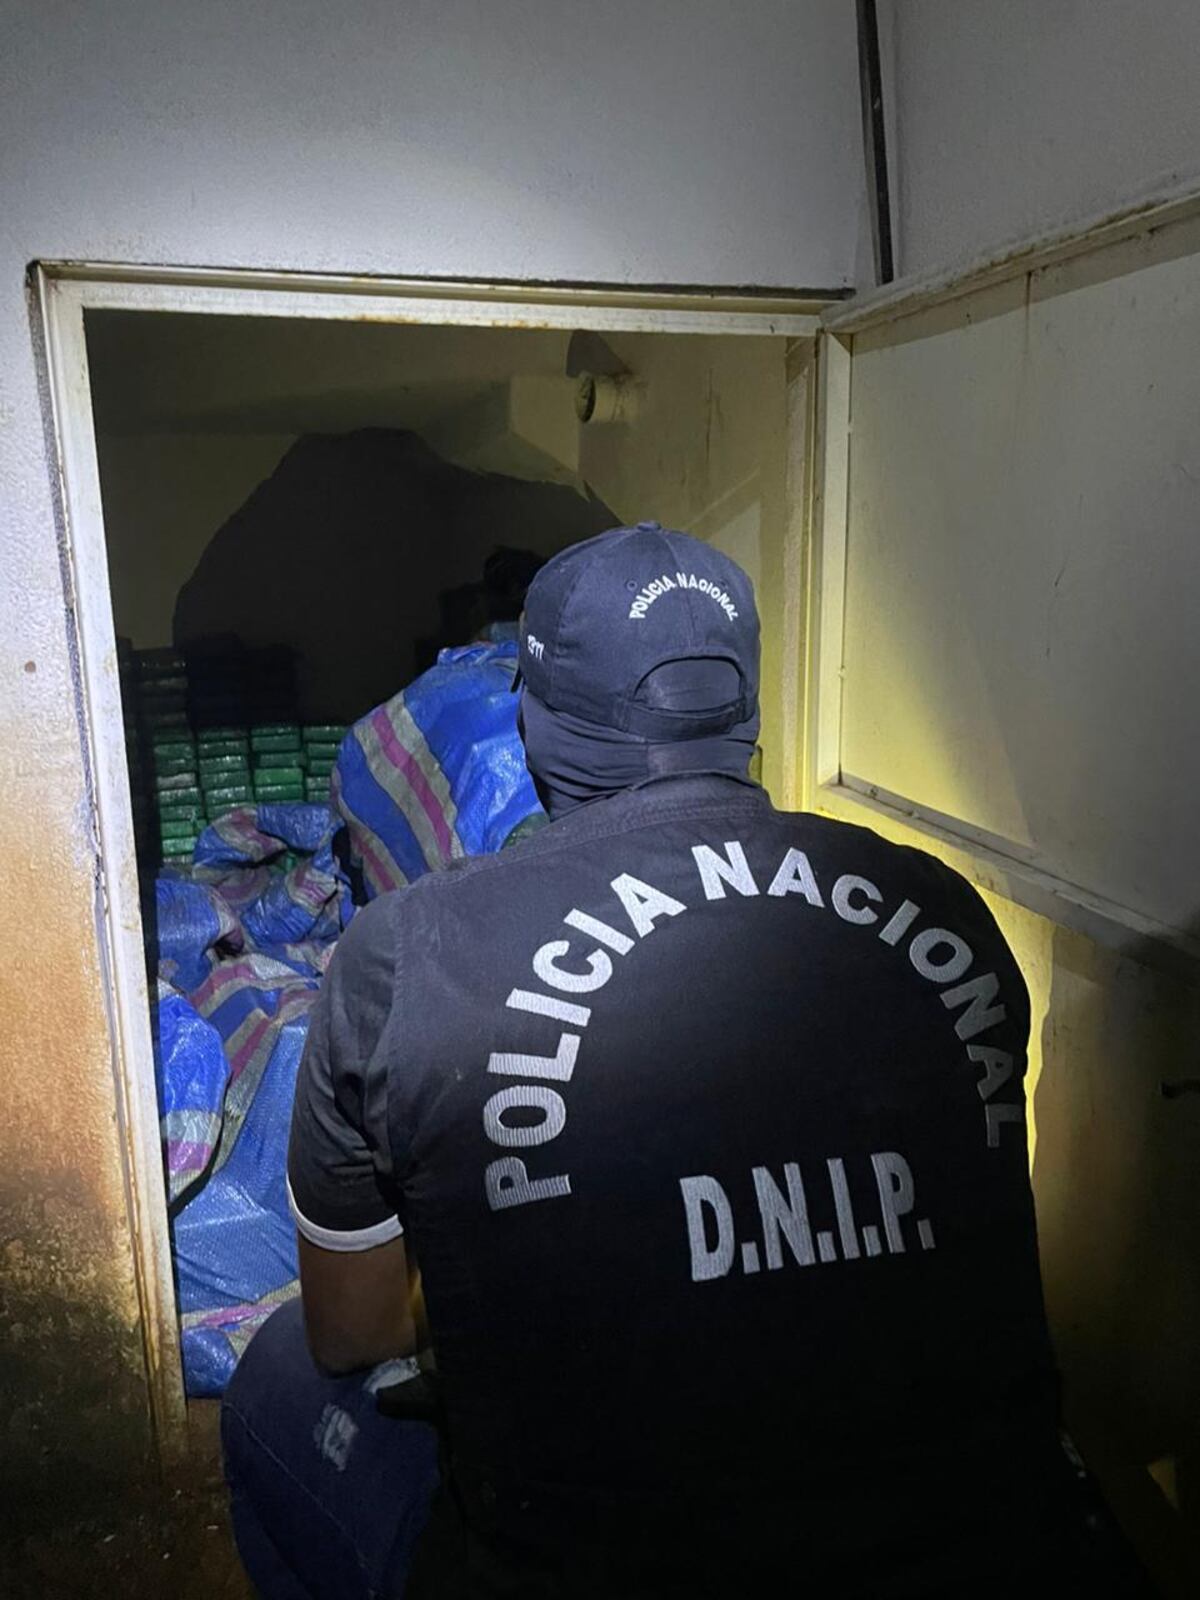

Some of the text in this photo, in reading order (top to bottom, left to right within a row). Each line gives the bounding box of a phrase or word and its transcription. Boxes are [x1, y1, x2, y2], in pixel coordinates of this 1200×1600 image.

[629, 571, 738, 621] POLICIA NACIONAL
[482, 841, 1023, 1211] POLICIA NACIONAL
[679, 1152, 936, 1282] D.N.I.P.
